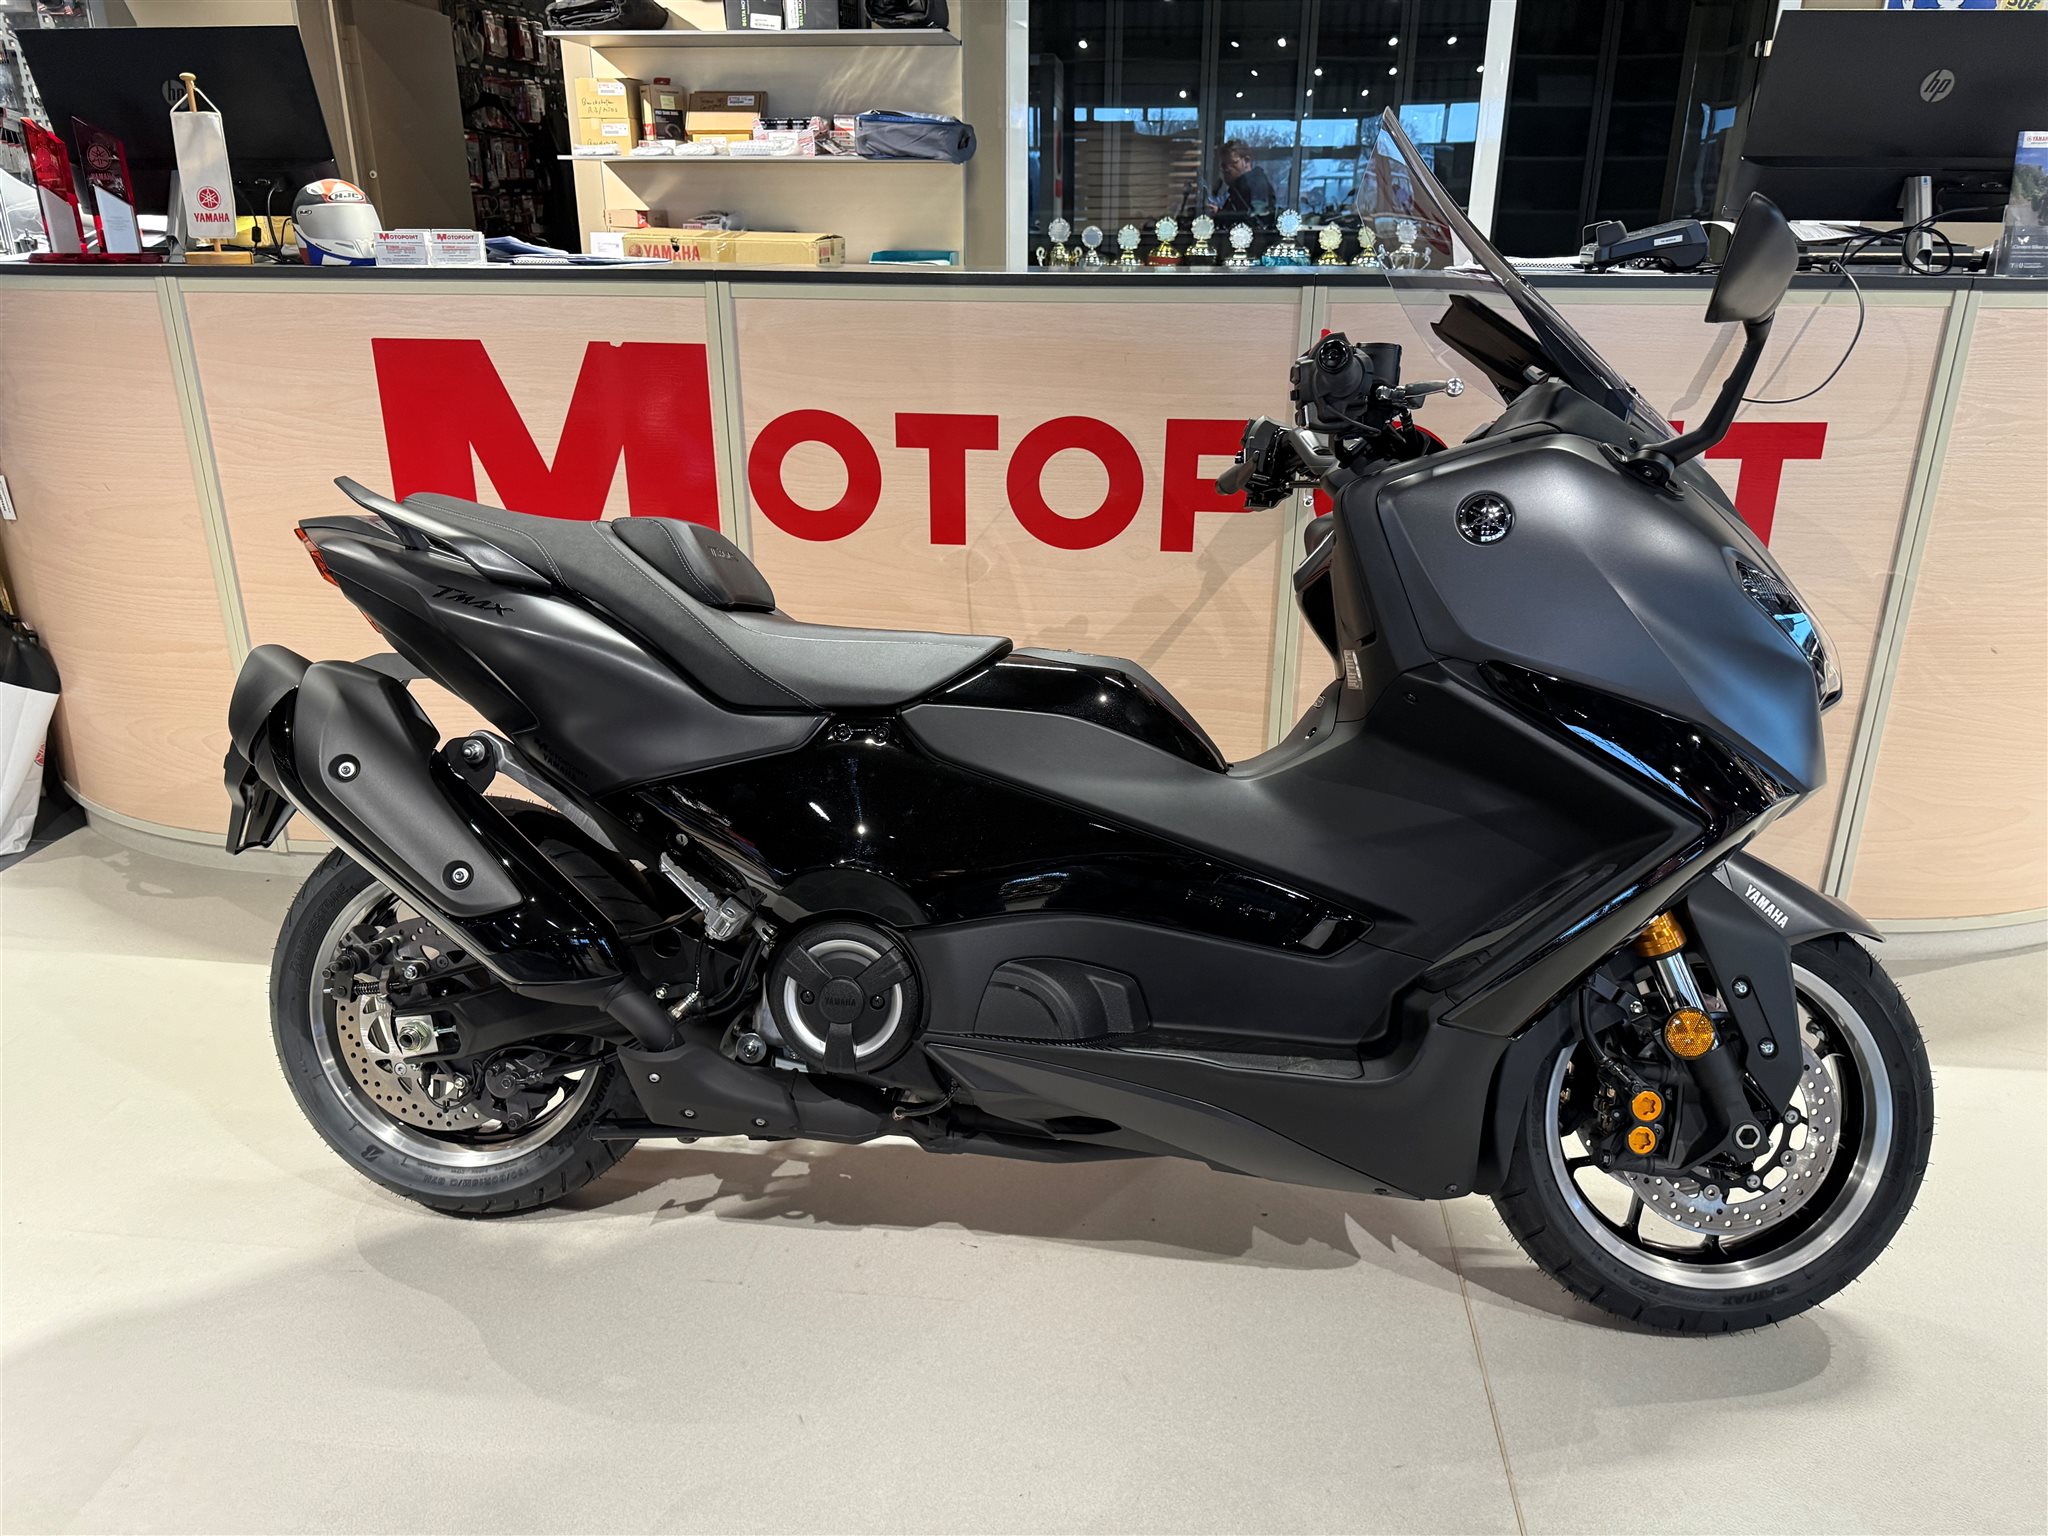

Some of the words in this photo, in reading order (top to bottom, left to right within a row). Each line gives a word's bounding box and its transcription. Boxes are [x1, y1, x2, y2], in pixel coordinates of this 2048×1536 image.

[194, 212, 230, 223] YAMAHA
[1745, 884, 1789, 928] YAMAHA
[824, 996, 857, 1007] YAMAHA
